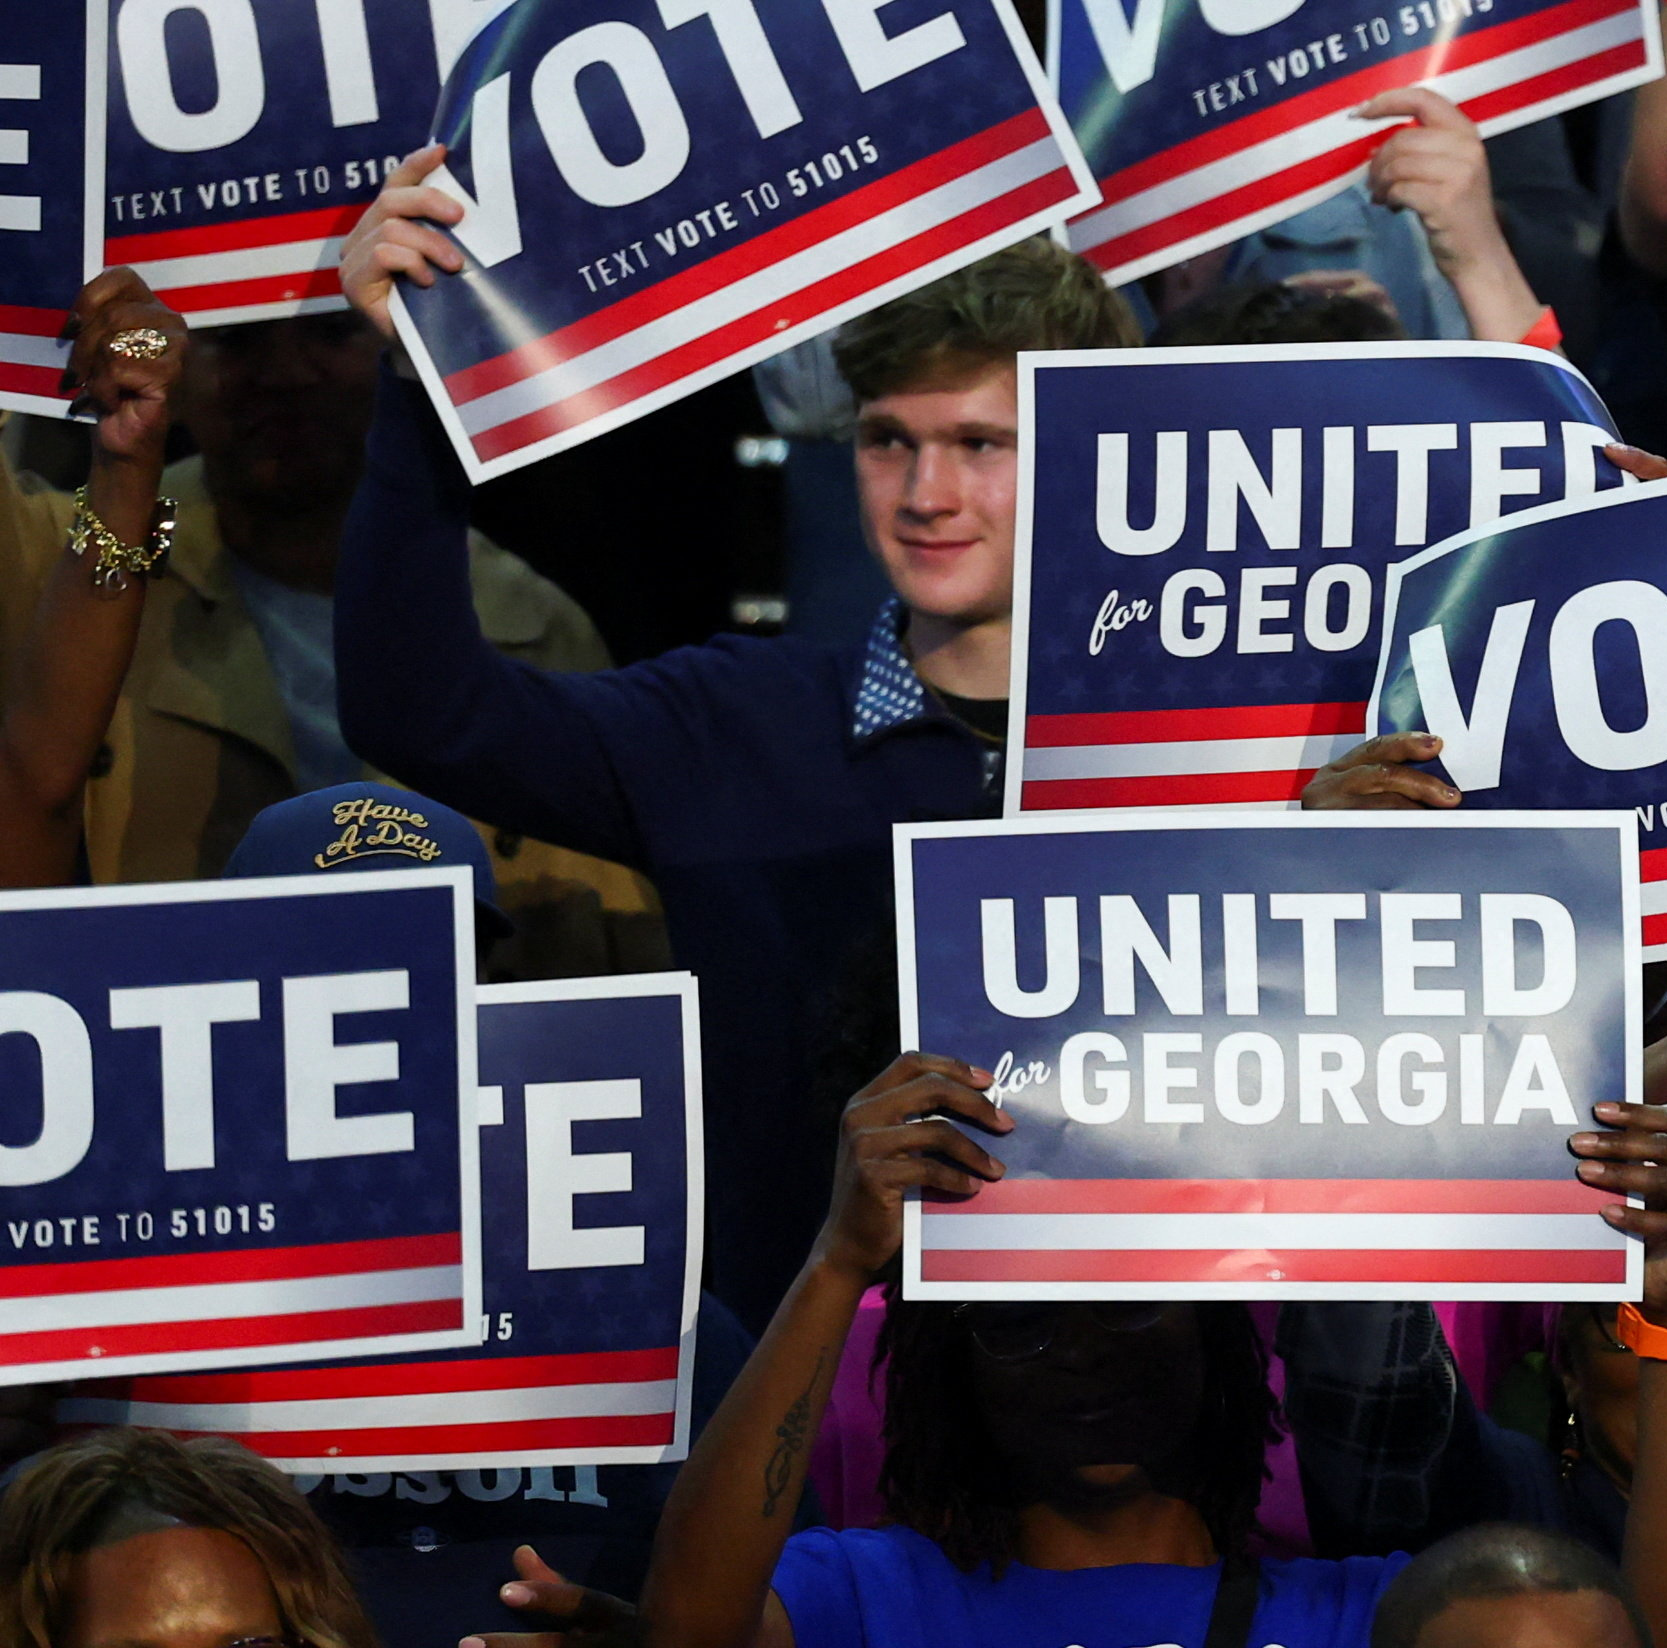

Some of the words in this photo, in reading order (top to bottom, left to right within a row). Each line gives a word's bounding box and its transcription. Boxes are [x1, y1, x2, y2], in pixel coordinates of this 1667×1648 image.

[1193, 70, 1260, 117] TEXT
[1267, 34, 1348, 84] VOTE
[1352, 16, 1392, 51] TO
[110, 186, 184, 221] TEXT
[198, 174, 282, 209] VOTE
[295, 167, 332, 195] TO
[344, 156, 400, 188] 510
[578, 240, 651, 294] TEXT
[653, 201, 739, 260] VOTE
[741, 181, 782, 215] TO
[789, 136, 879, 199] 51015
[1088, 590, 1152, 655] for
[327, 824, 362, 856] A
[366, 820, 441, 861] Day
[333, 798, 429, 827] Have
[980, 892, 1577, 1019] UNITED
[0, 969, 415, 1187] OTE
[989, 1052, 1051, 1107] for
[1059, 1032, 1578, 1126] GEORGIA
[8, 1216, 101, 1249] VOTE
[116, 1210, 153, 1242] TO
[171, 1203, 276, 1239] 51015
